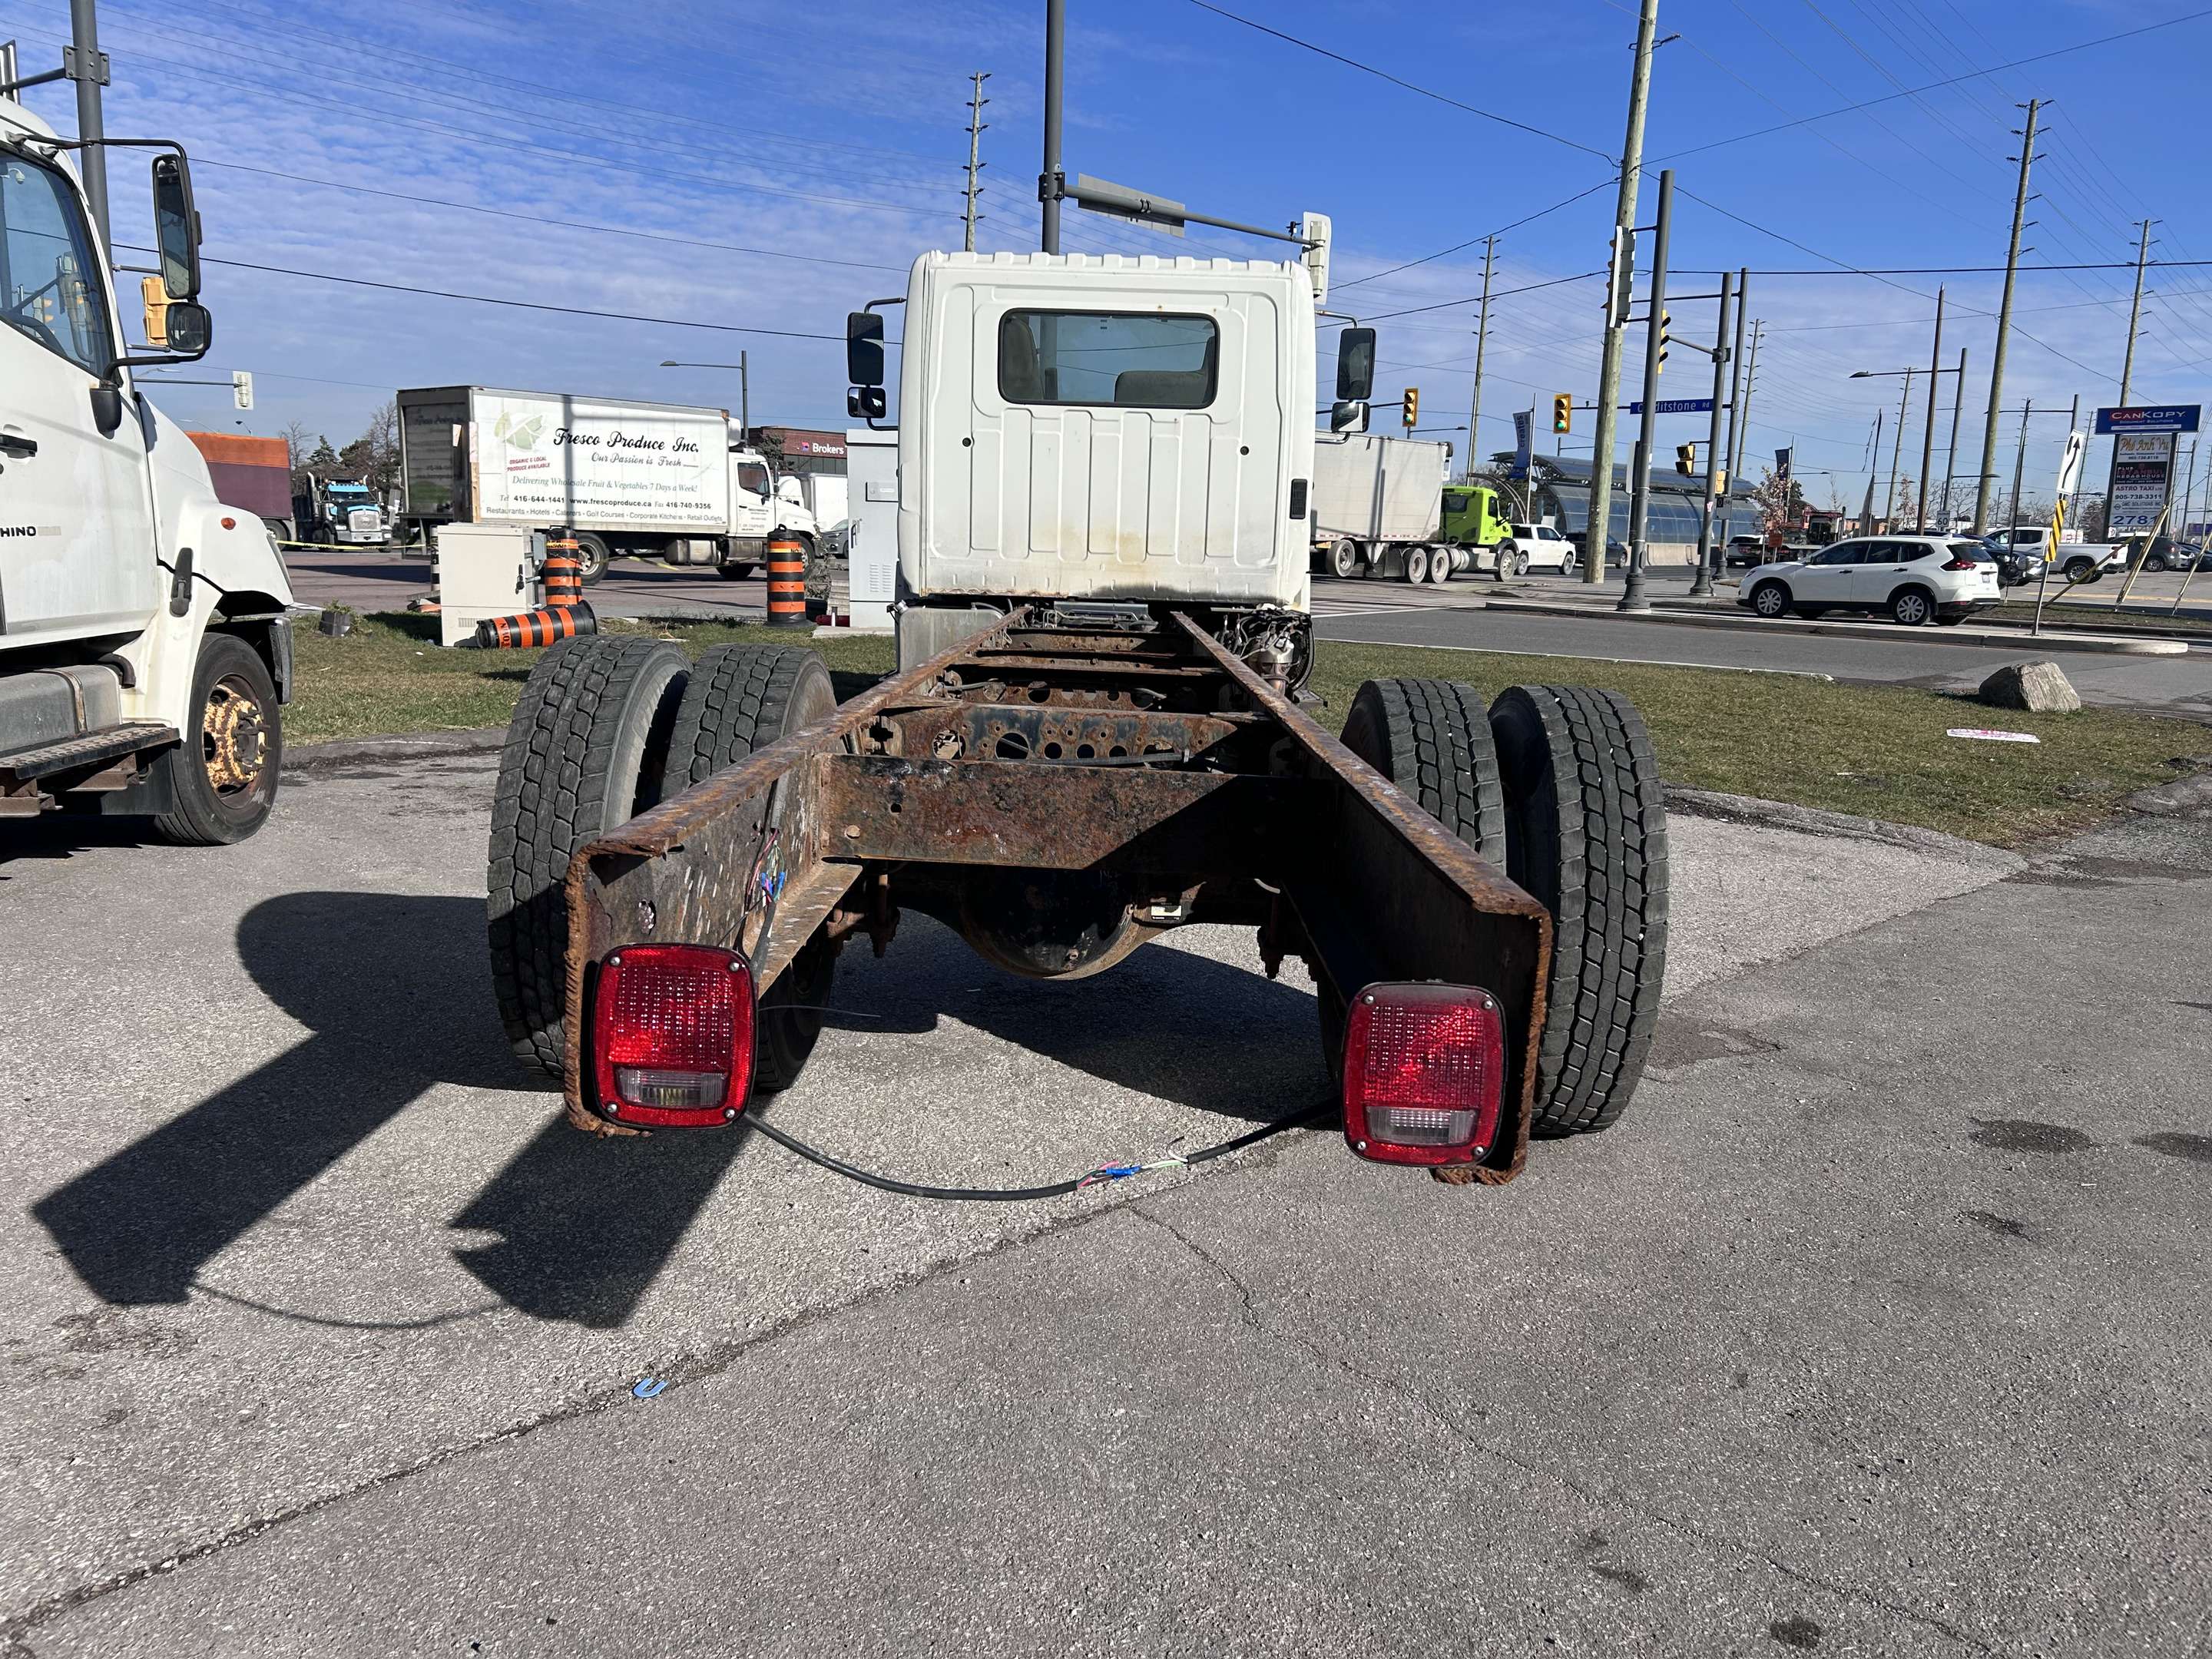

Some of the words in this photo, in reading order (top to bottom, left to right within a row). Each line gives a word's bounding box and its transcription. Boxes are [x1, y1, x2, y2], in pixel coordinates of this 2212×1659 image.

[1637, 401, 1697, 412] Cditstone
[553, 428, 600, 445] Fresco
[607, 430, 665, 451] Produce
[673, 436, 699, 452] Inc.
[813, 442, 844, 455] Brokers
[591, 452, 608, 462] Our
[609, 452, 644, 464] Passion
[646, 455, 653, 465] is
[657, 455, 682, 466] Fresh
[512, 475, 549, 487] Delivering
[551, 478, 586, 487] Wholesale
[588, 479, 604, 488] Fruit
[614, 481, 648, 491] Vegetables
[655, 483, 671, 492] Days
[513, 495, 565, 504] 416-644-1441
[569, 498, 652, 507] www.frescoproduce.ca
[486, 507, 525, 515] Restaurants
[555, 508, 581, 517] Caterers
[629, 512, 658, 520] Corporate
[0, 526, 36, 538] HINO
